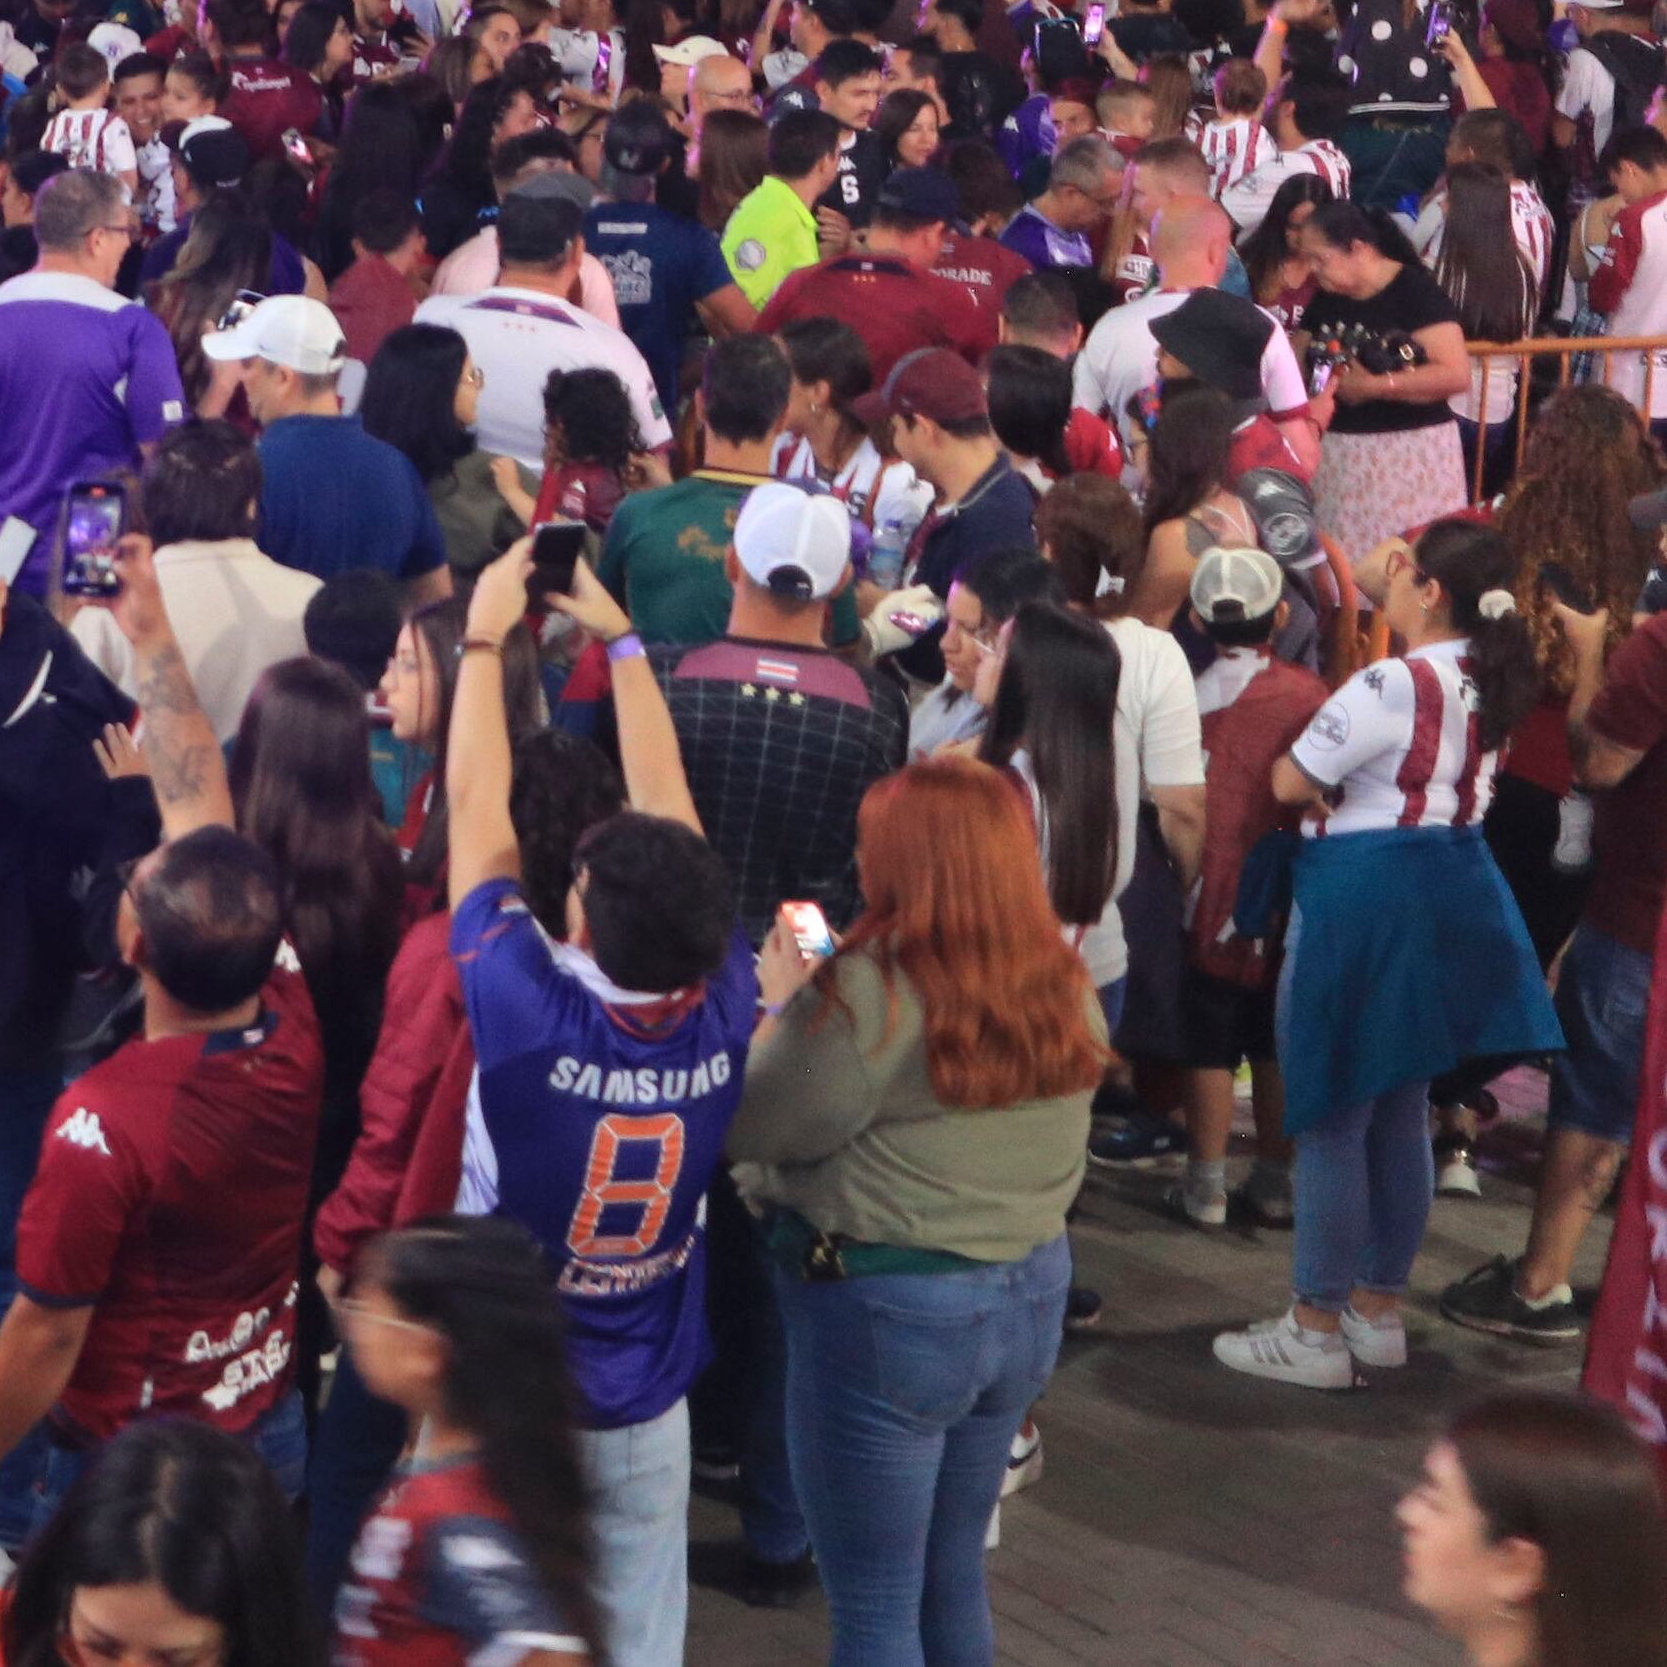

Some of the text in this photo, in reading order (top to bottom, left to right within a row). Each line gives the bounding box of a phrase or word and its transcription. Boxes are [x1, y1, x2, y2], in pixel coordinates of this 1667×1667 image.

[841, 174, 860, 205] S
[548, 1049, 732, 1106] SAMSUNG
[567, 1111, 685, 1257] 8
